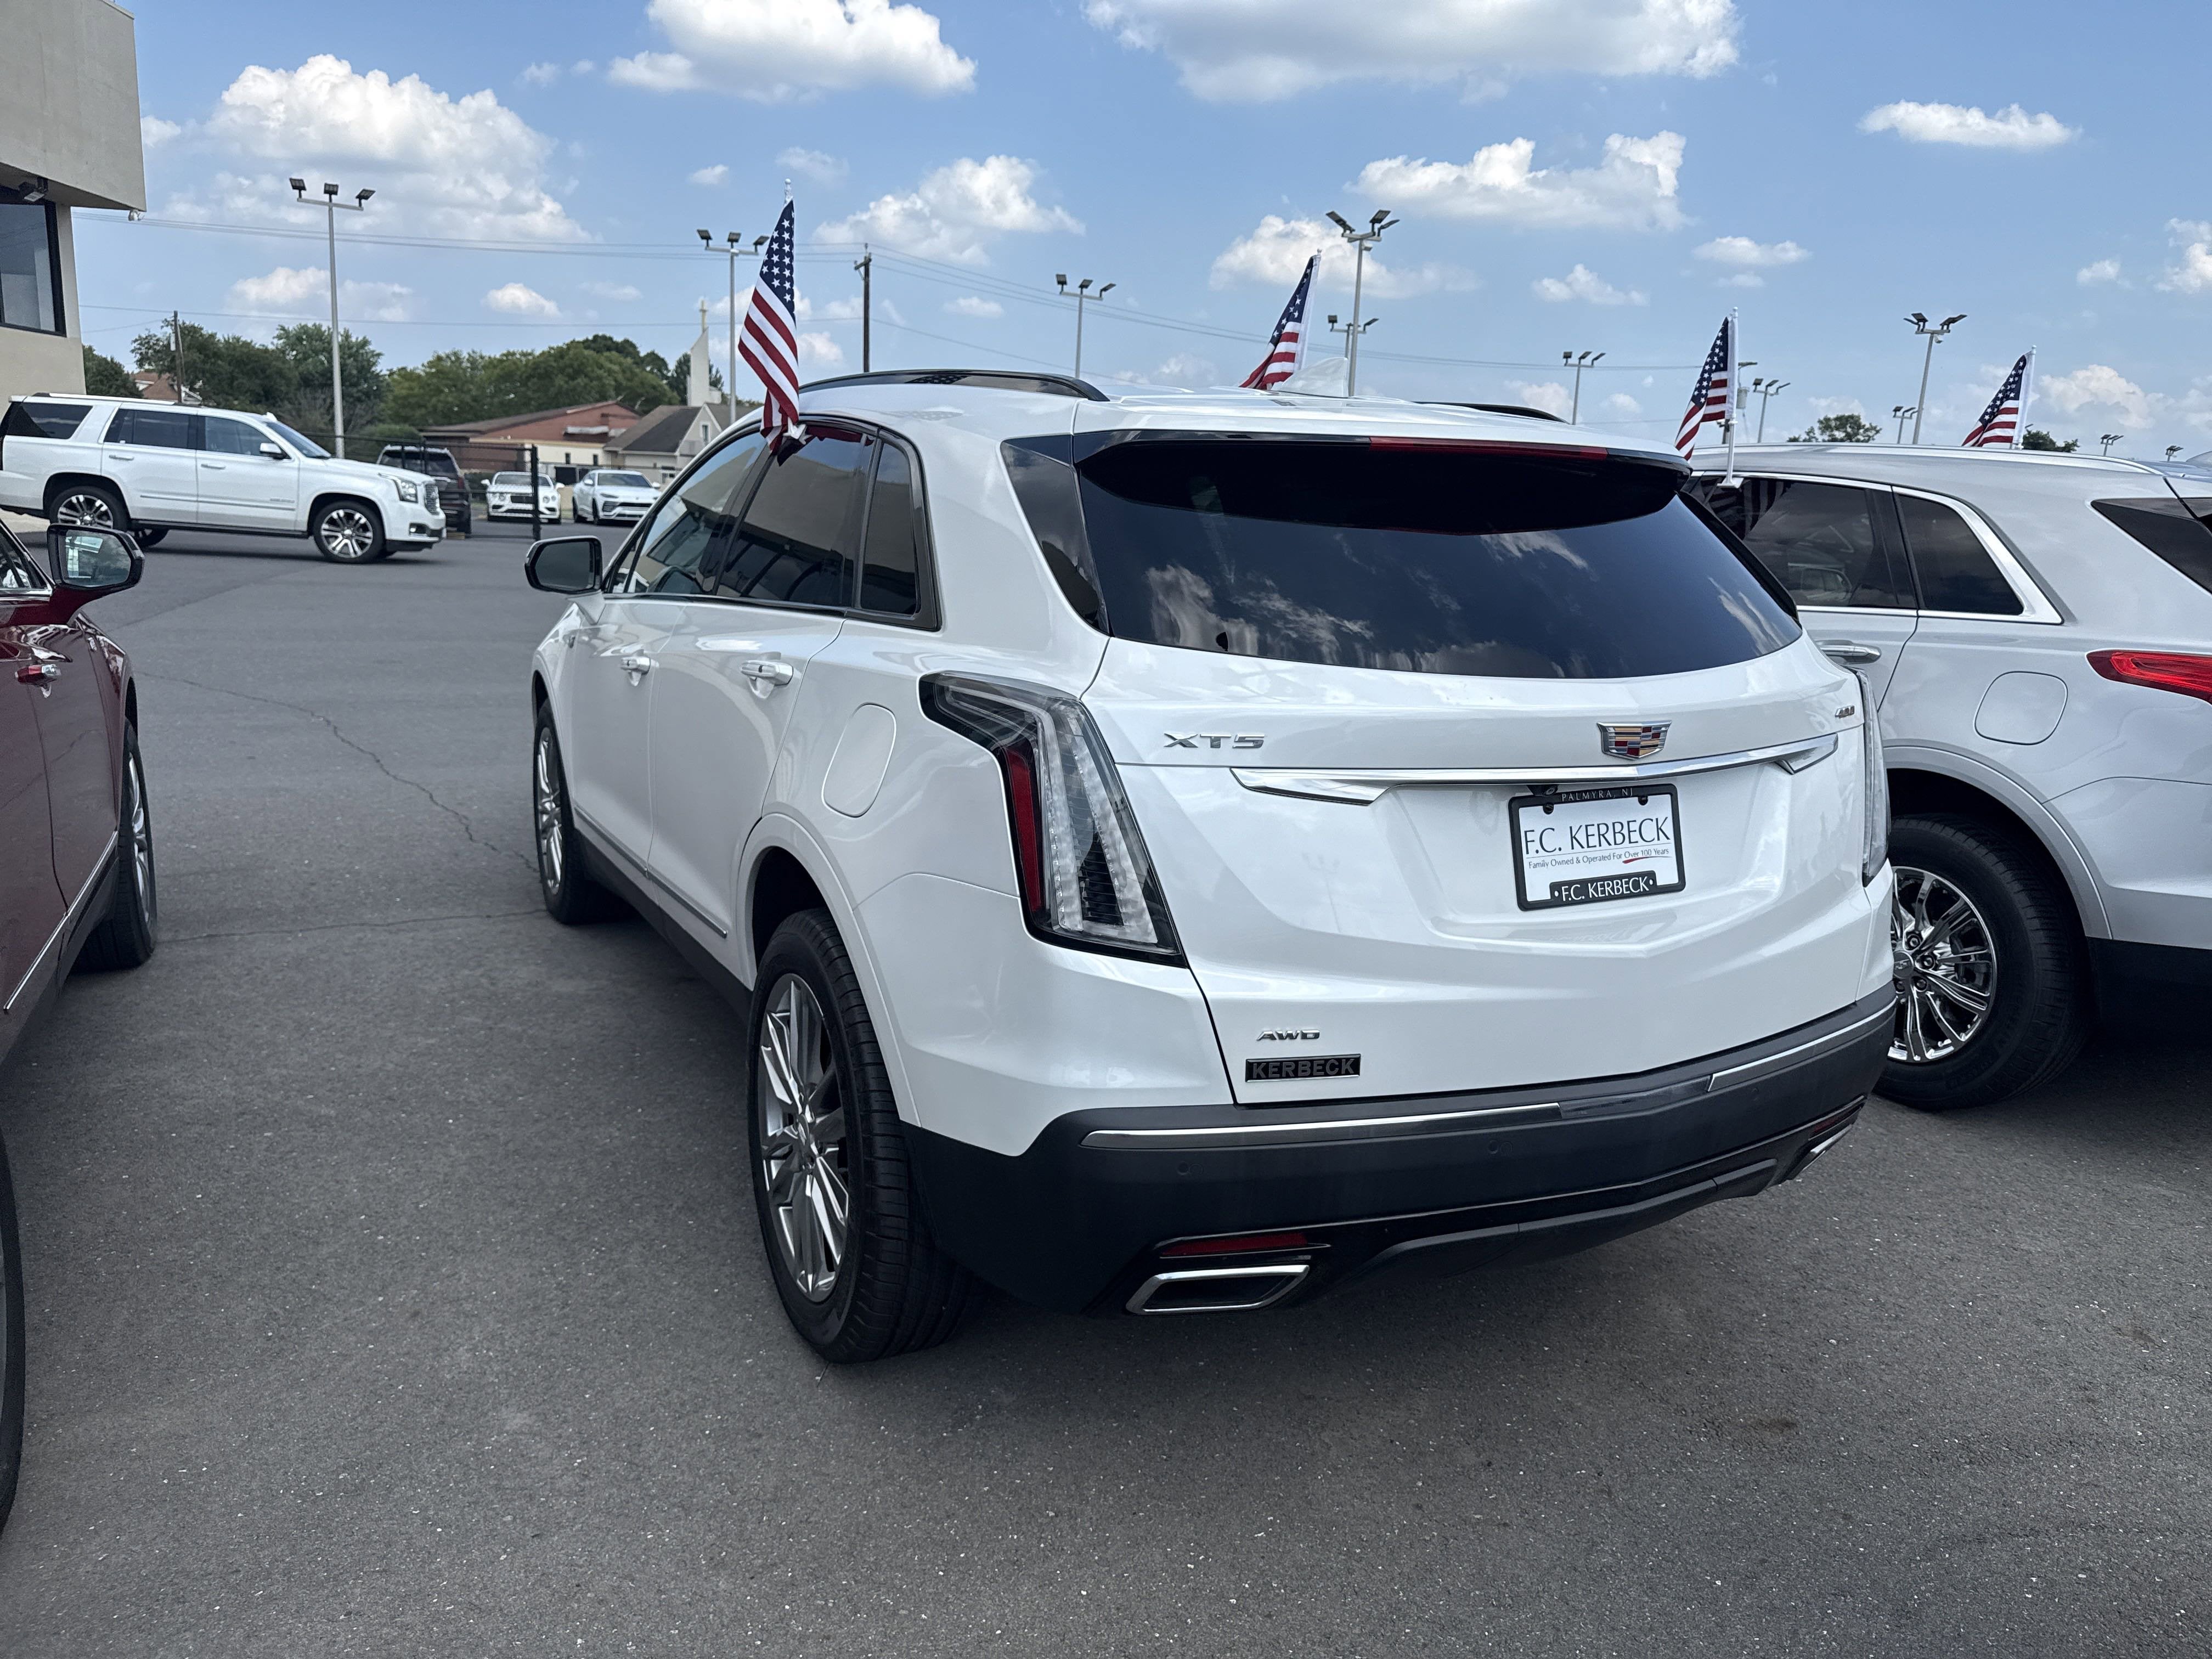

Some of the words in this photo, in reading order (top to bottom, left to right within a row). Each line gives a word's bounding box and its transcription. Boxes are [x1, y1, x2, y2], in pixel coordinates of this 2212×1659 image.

[1163, 733, 1266, 748] XT5
[1562, 790, 1616, 802] PALMYRA,
[1622, 787, 1633, 797] NJ
[1524, 827, 1561, 854] F.C.
[1570, 816, 1671, 850] KERBECK
[1528, 859, 1549, 869] Family
[1550, 857, 1574, 867] Owned
[1582, 853, 1611, 865] Operated
[1613, 852, 1623, 860] For
[1561, 884, 1585, 902] F.C.
[1588, 876, 1650, 898] KERBECK
[1256, 1030, 1321, 1041] AWD
[1252, 1058, 1355, 1079] KERBECK
